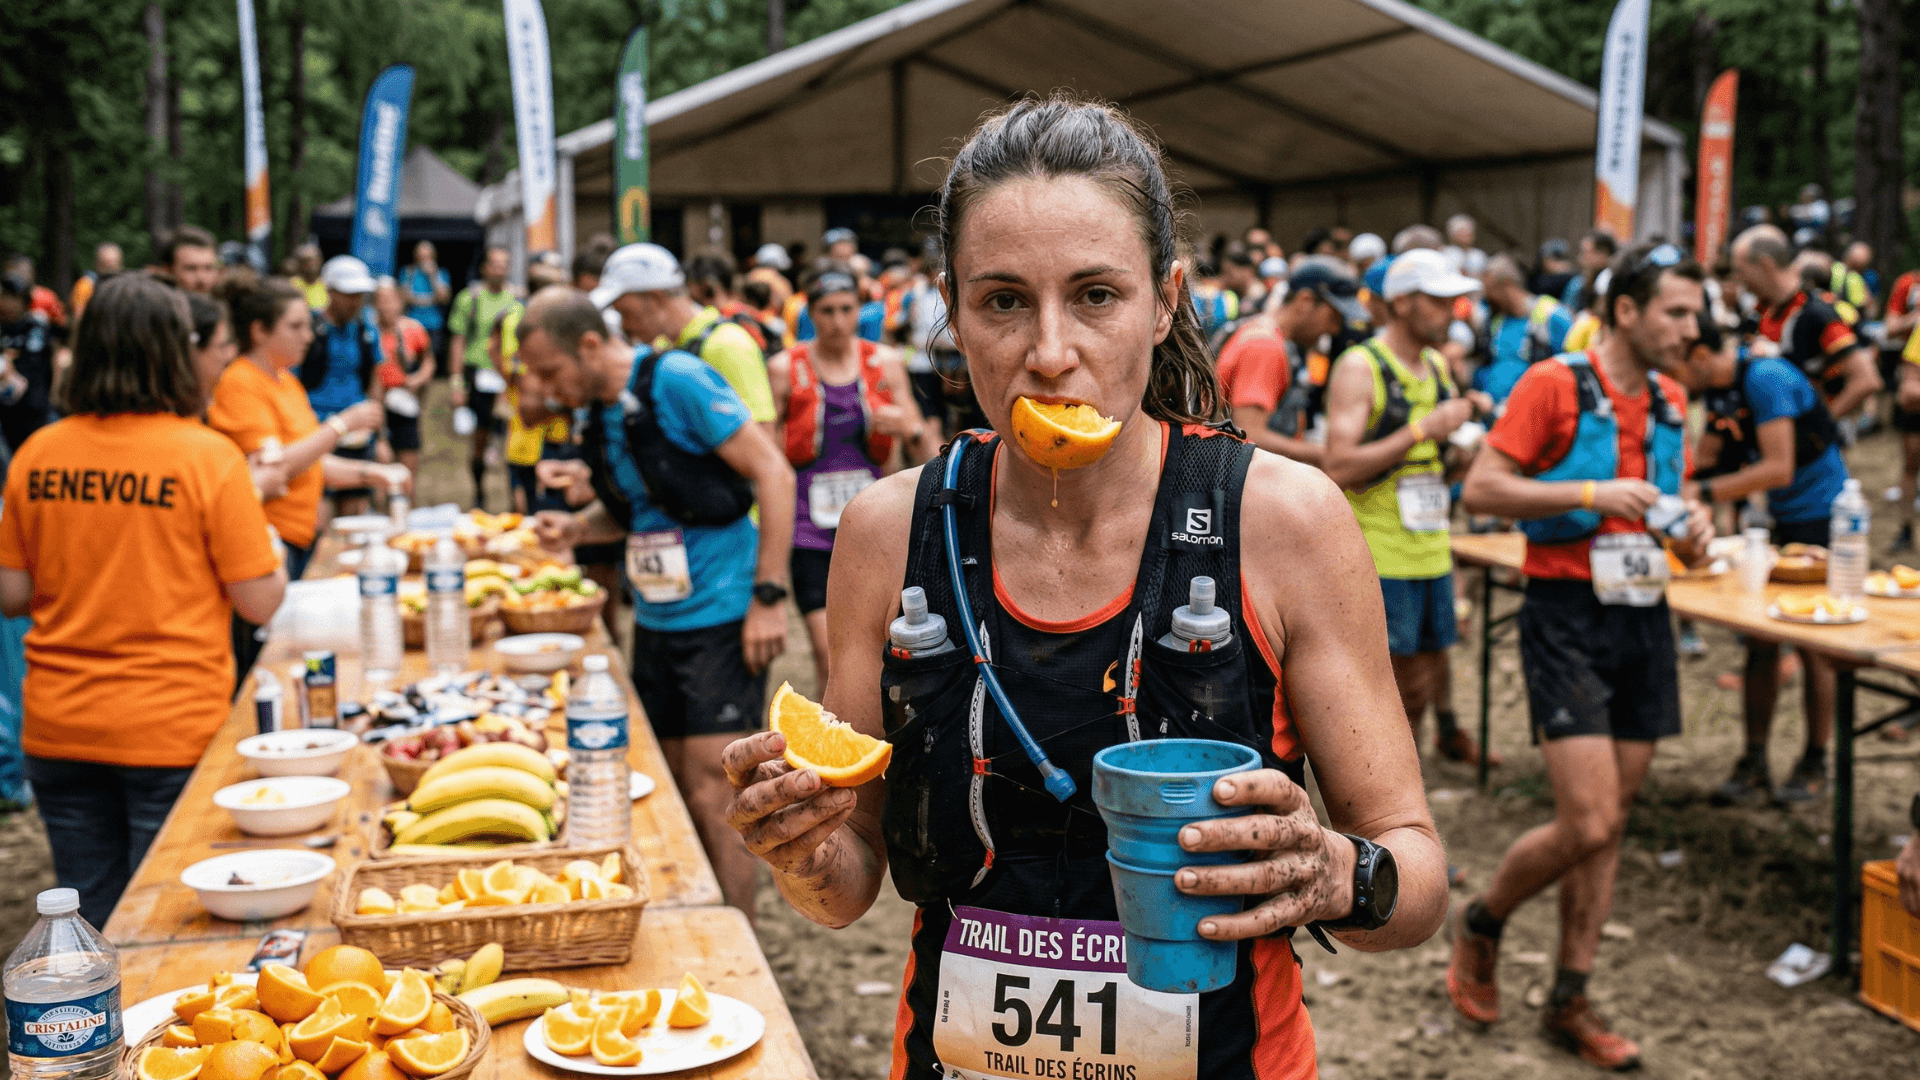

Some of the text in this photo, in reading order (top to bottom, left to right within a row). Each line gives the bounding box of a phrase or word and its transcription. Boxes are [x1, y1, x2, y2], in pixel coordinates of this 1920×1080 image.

[28, 469, 177, 509] BENEVOLE
[1171, 531, 1223, 545] salomon
[959, 918, 1127, 963] TRAIL DES ÉCRI
[26, 1013, 105, 1034] CRISTALINE
[991, 972, 1118, 1056] 541
[984, 1051, 1030, 1075] TRAIL
[1035, 1058, 1067, 1079] DES
[1072, 1057, 1137, 1080] ÉCRINS
